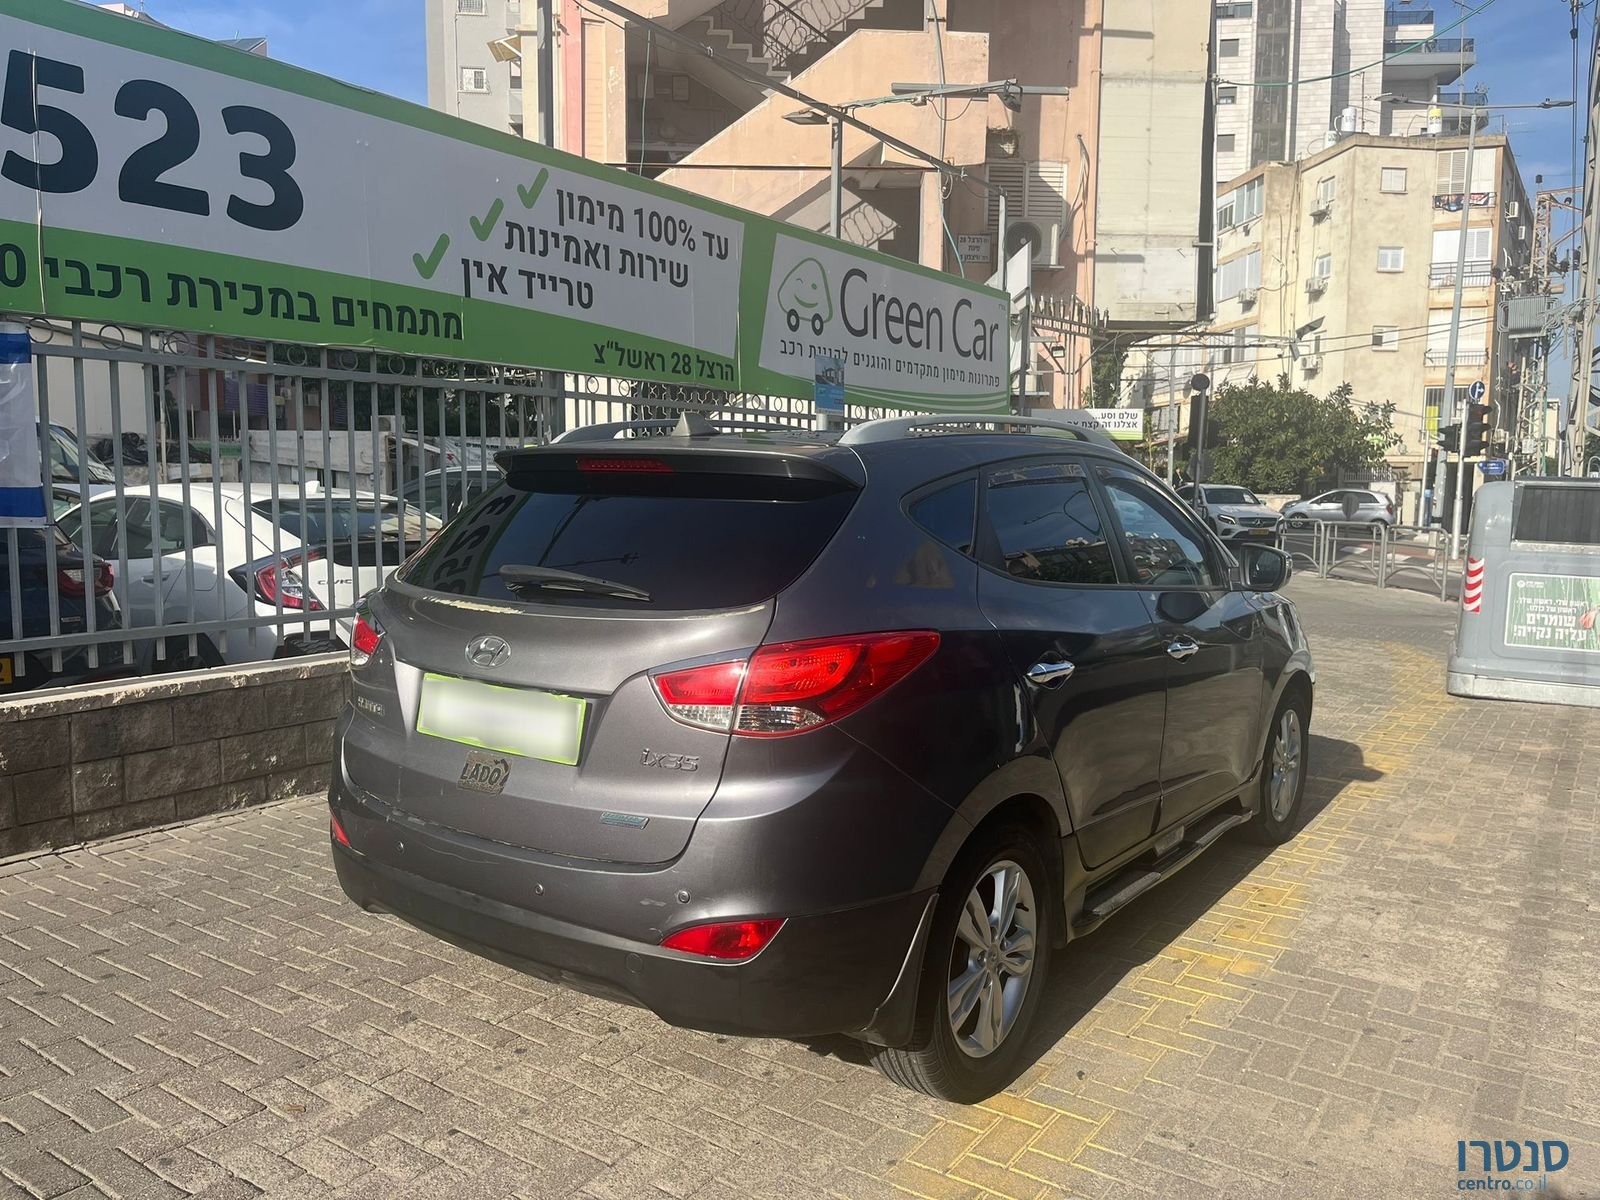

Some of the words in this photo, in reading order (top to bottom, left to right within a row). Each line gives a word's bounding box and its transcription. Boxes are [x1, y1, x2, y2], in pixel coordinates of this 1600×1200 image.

[0, 49, 304, 231] 523
[556, 188, 624, 233] מימון
[634, 207, 696, 252] 100%
[504, 220, 610, 271] ואמינות
[702, 230, 729, 260] עד
[43, 256, 151, 303] רכבי
[461, 257, 508, 298] אין
[618, 248, 689, 288] שירות
[167, 272, 321, 323] במכירת
[518, 268, 594, 310] טרייד
[332, 295, 463, 340] מתמחים
[840, 268, 943, 353] Green
[952, 298, 999, 362] Car
[780, 339, 803, 357] רכב
[853, 352, 891, 371] והוגנים
[671, 352, 691, 375] 28
[696, 354, 734, 382] הרצל
[895, 359, 939, 380] מתקדמים
[943, 367, 965, 383] מימון
[968, 371, 1000, 387] פתרונות
[1114, 420, 1138, 428] אצלנו
[1118, 411, 1138, 420] שלם
[1513, 624, 1552, 640] נקייה!
[1526, 613, 1577, 627] שומרים
[1555, 627, 1587, 641] עליה
